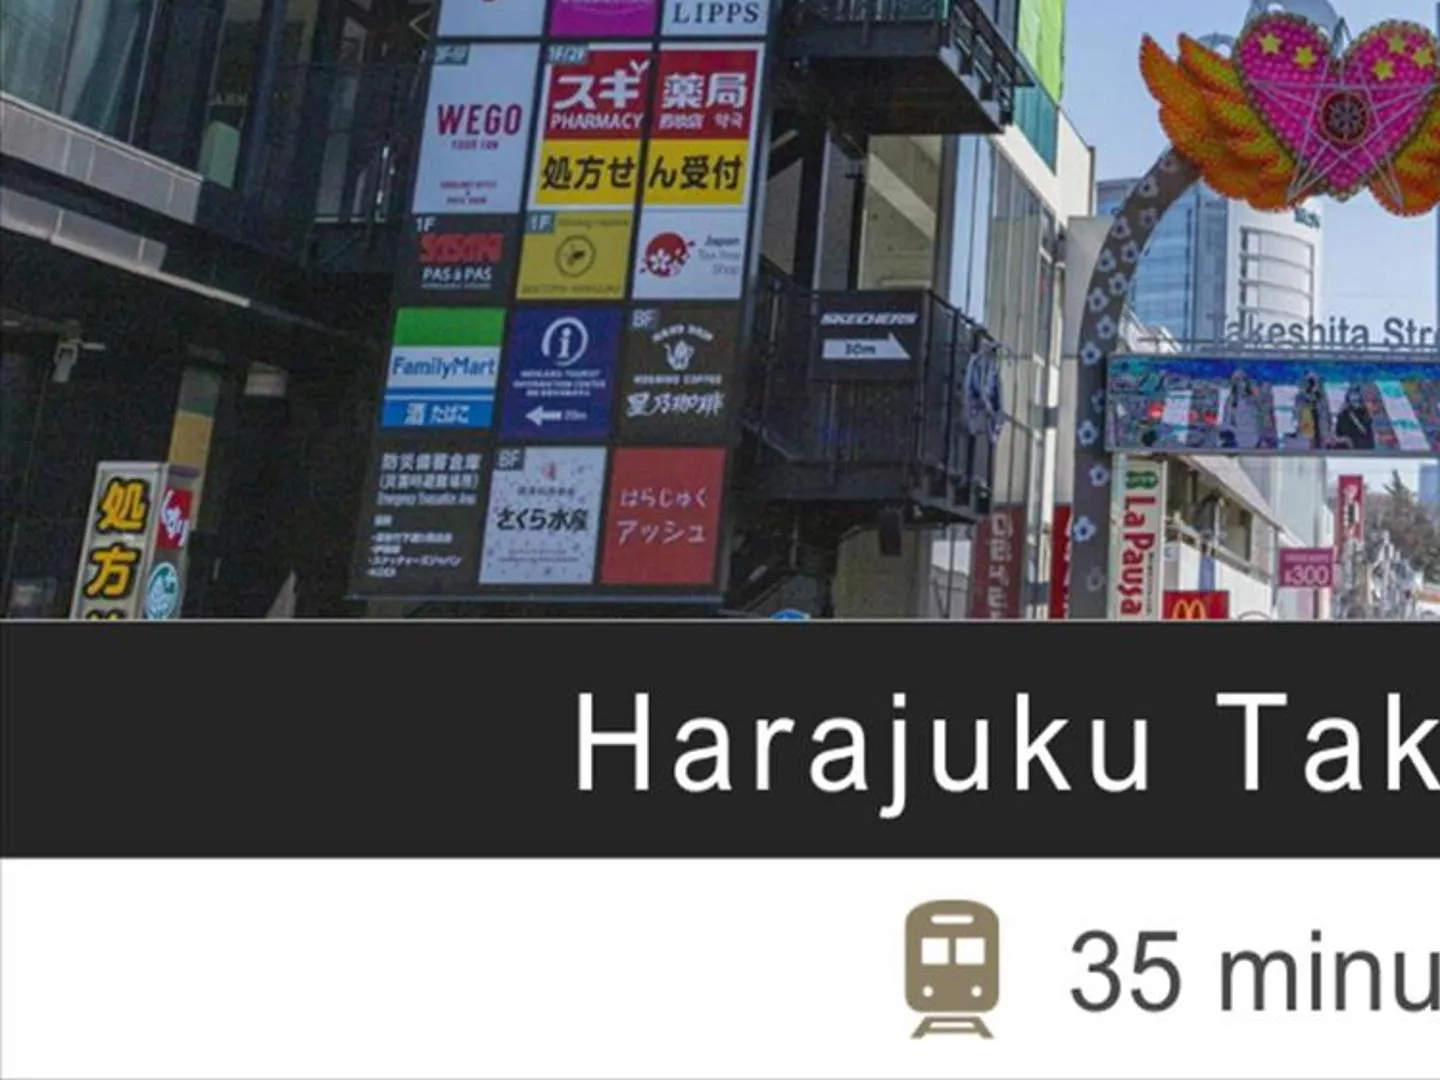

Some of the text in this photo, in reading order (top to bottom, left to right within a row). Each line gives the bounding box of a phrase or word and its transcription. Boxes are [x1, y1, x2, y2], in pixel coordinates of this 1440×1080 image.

[672, 0, 761, 25] LIPPS
[436, 102, 523, 136] WEGO
[550, 112, 645, 130] PHARMACY
[541, 154, 743, 192] 処方せん受付
[414, 217, 436, 233] 1F
[531, 214, 551, 231] 1F
[422, 266, 451, 282] PAS
[463, 266, 493, 282] PAS
[392, 356, 496, 379] FamilyMart
[620, 485, 708, 510] はらじゅく
[496, 507, 589, 532] さくら水産
[615, 520, 706, 546] アッシュ
[83, 476, 151, 620] 処方
[1118, 496, 1156, 615] La Pausa
